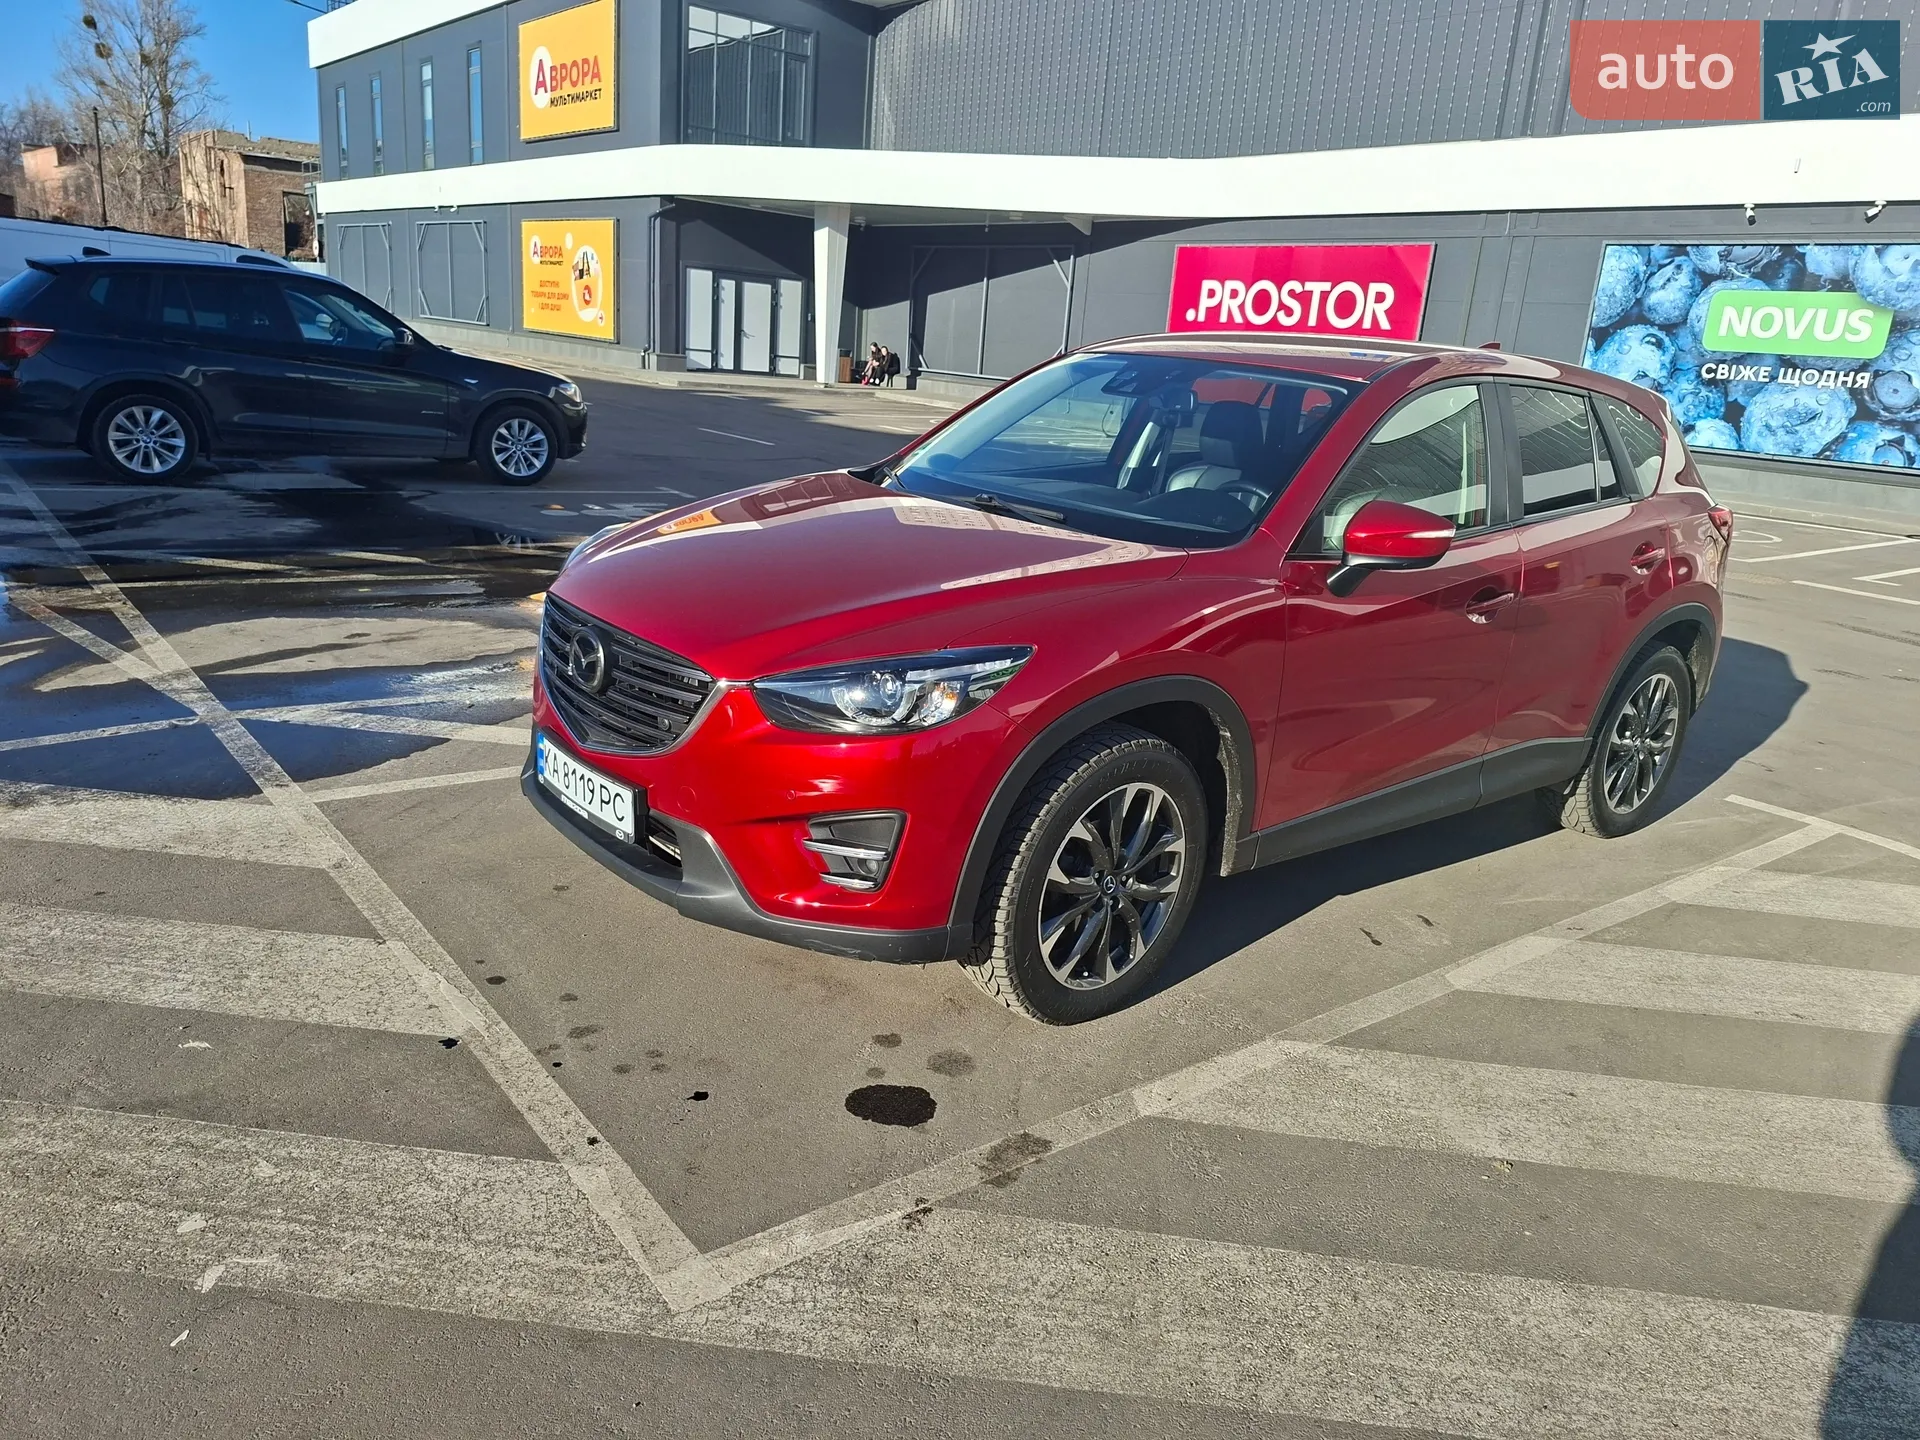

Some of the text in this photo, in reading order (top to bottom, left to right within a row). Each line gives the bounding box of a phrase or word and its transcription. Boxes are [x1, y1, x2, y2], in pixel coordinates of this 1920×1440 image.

[534, 55, 602, 95] АВРОРА
[549, 87, 602, 108] МУЛЬТИМАРКЕТ
[532, 241, 564, 259] АВРОРА
[1185, 279, 1395, 331] .PROSTOR
[1718, 305, 1875, 343] NOVUS
[1701, 362, 1872, 390] СВІЖЕ ЩОДНЯ
[563, 761, 595, 806] 8119
